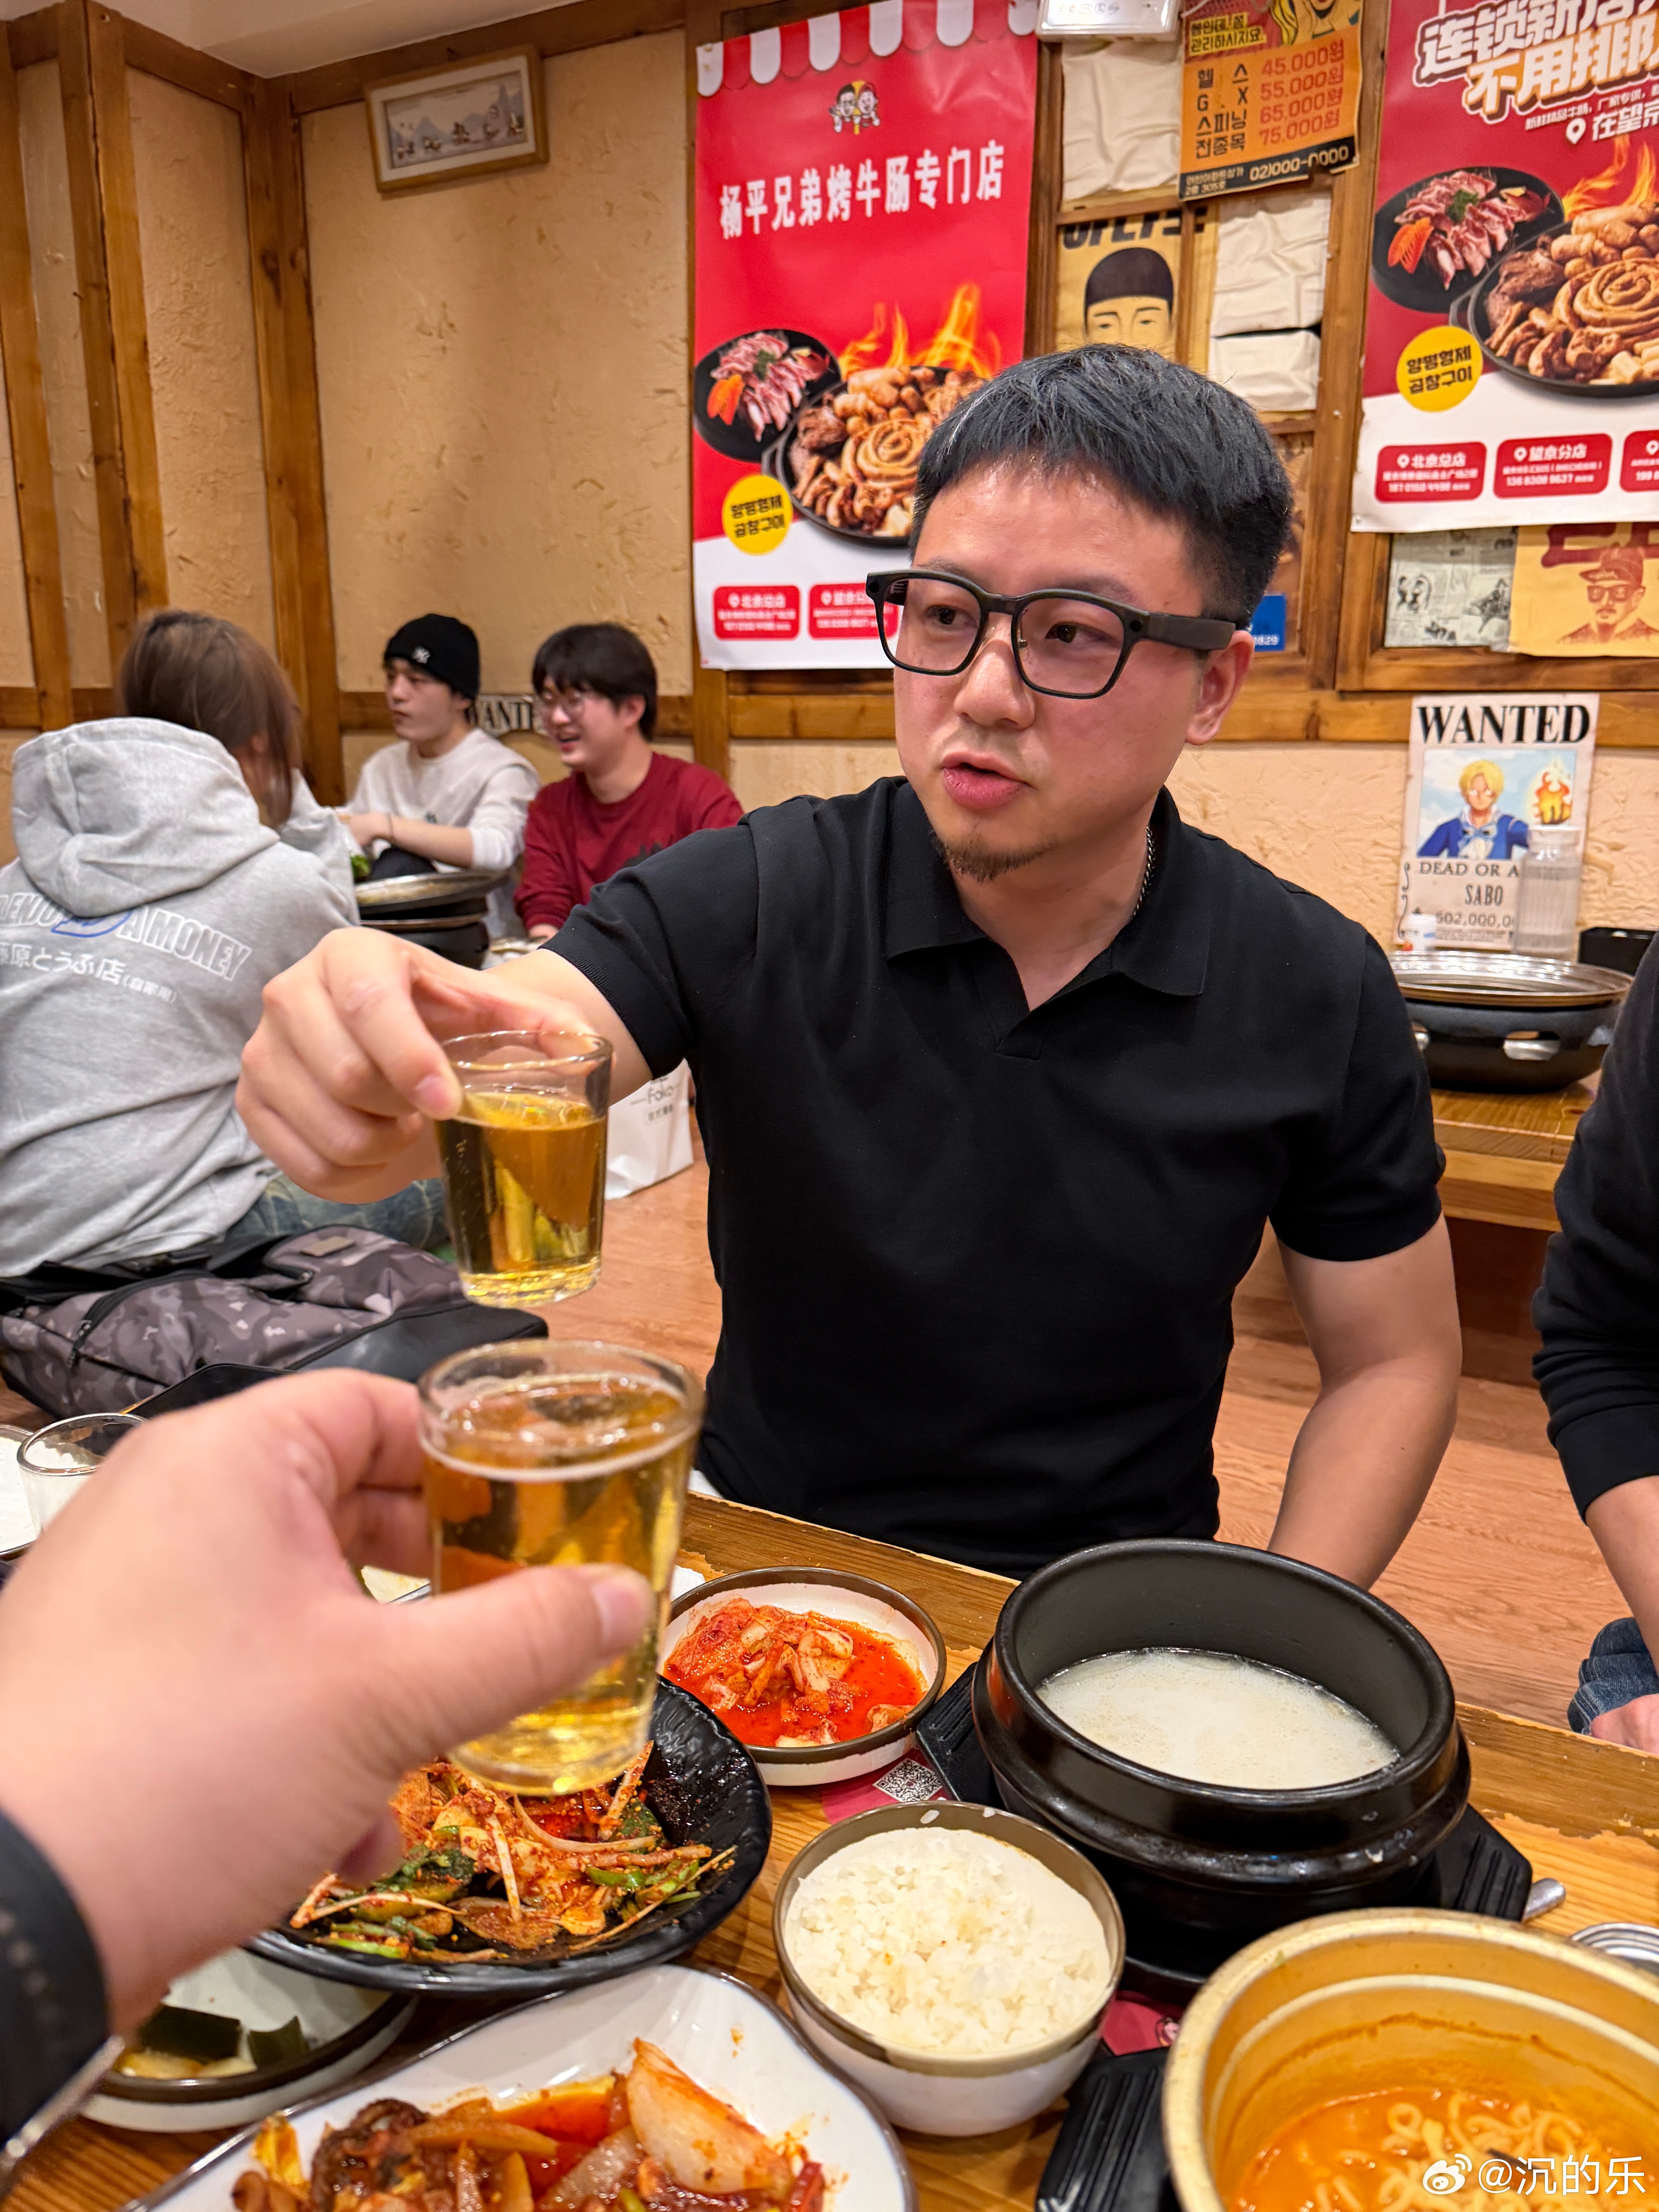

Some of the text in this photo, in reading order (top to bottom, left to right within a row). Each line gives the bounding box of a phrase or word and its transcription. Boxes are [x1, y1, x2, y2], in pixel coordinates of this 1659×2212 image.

[1420, 0, 1659, 79] 连锁新店
[720, 139, 1005, 239] 杨平兄弟烤牛肠专门店
[1407, 345, 1471, 375] 양평형제
[1408, 366, 1472, 395] 곱창구이
[1417, 705, 1590, 744] WANTED
[1419, 862, 1468, 876] DEAD
[1475, 863, 1501, 877] OR
[1465, 884, 1503, 907] SABO
